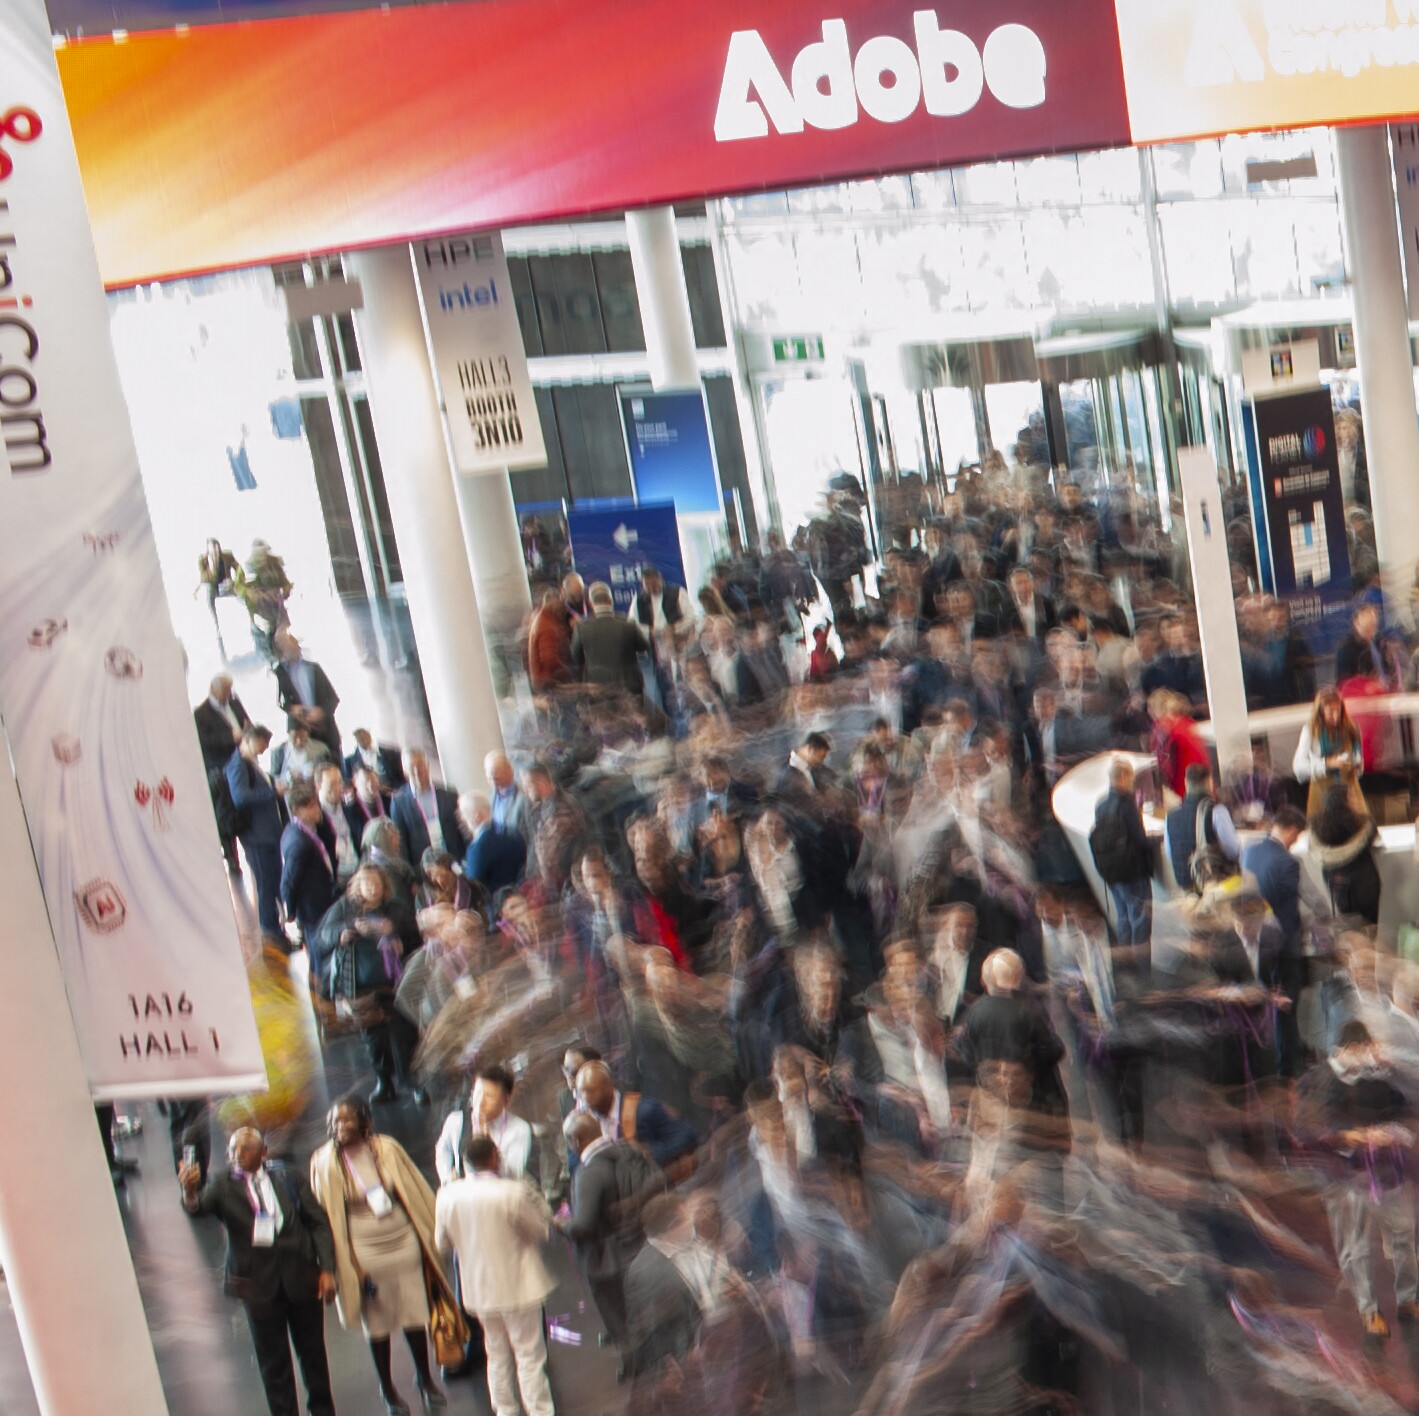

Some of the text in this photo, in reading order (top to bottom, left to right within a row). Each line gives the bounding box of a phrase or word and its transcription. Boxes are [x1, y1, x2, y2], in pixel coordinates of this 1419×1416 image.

[714, 9, 1046, 142] Adobe
[423, 236, 495, 269] HPE
[438, 278, 499, 312] intel
[457, 354, 512, 392] HALL 3
[465, 391, 518, 420] BOOTH
[129, 989, 194, 1020] 1A16
[120, 1027, 220, 1059] HALL 1
